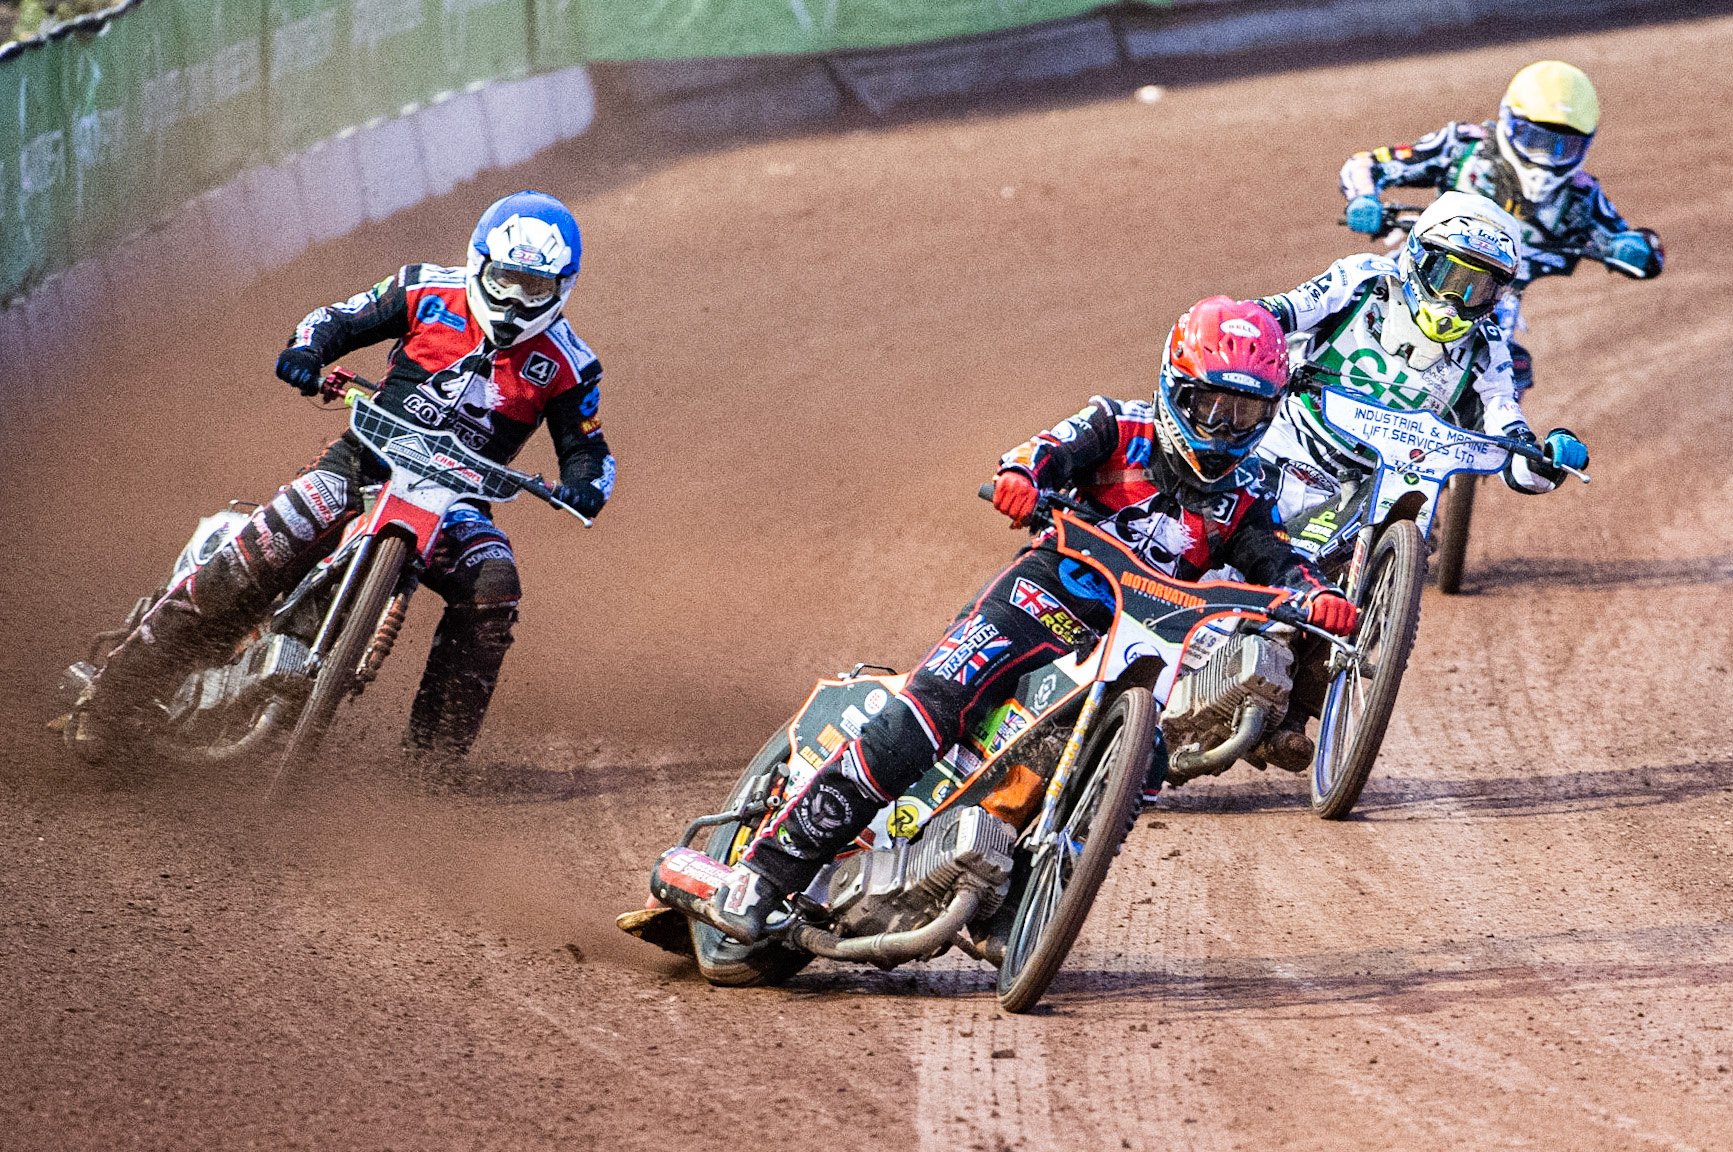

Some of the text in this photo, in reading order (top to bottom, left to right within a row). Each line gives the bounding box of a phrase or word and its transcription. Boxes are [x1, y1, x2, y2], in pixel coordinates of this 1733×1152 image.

[531, 361, 550, 379] 4
[402, 393, 491, 451] COTS
[1354, 407, 1489, 454] INDUSTRIAL & MARINE
[1363, 423, 1475, 464] LIFT SERVICES LTD
[1216, 498, 1229, 516] 3
[1120, 570, 1207, 613] MOTORVATION
